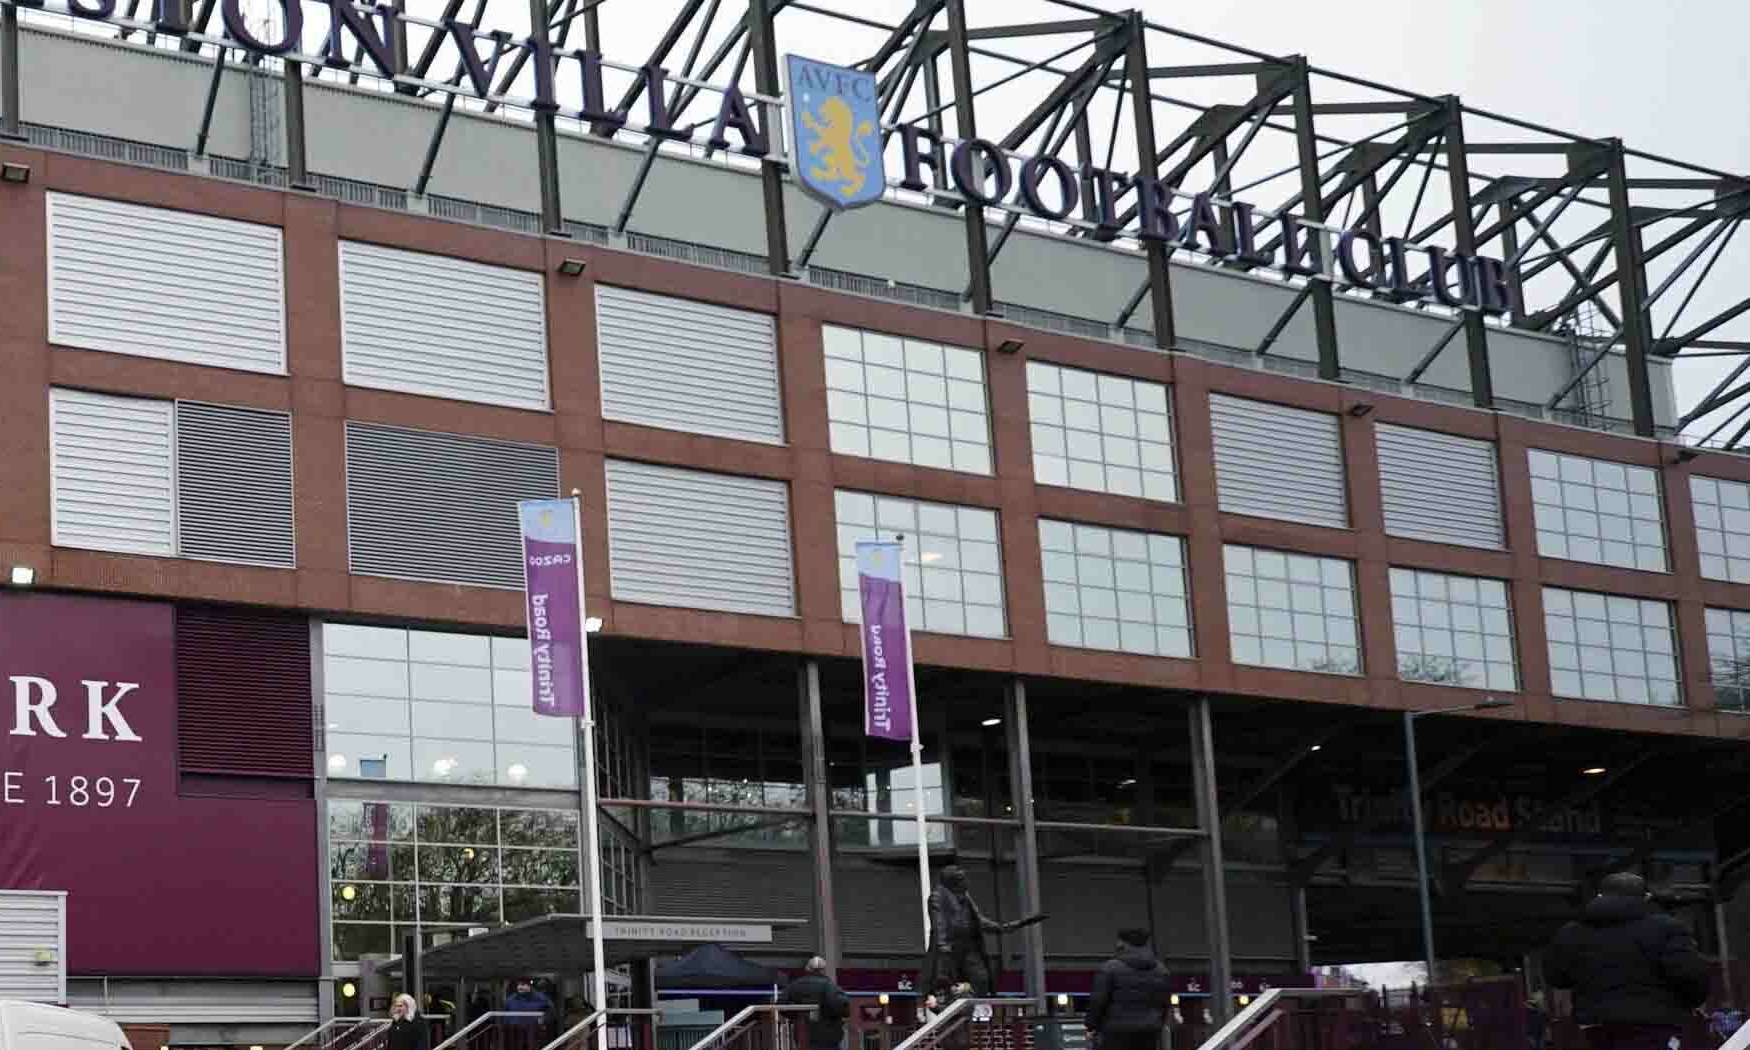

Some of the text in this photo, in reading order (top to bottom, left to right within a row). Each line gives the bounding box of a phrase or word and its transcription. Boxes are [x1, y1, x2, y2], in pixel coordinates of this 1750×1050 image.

[798, 64, 872, 103] AVFC
[444, 21, 771, 157] VILLA
[899, 122, 1321, 276] FOOTBALL
[1339, 230, 1508, 315] CLUB
[45, 775, 142, 808] 1897
[1437, 791, 1511, 830] Road
